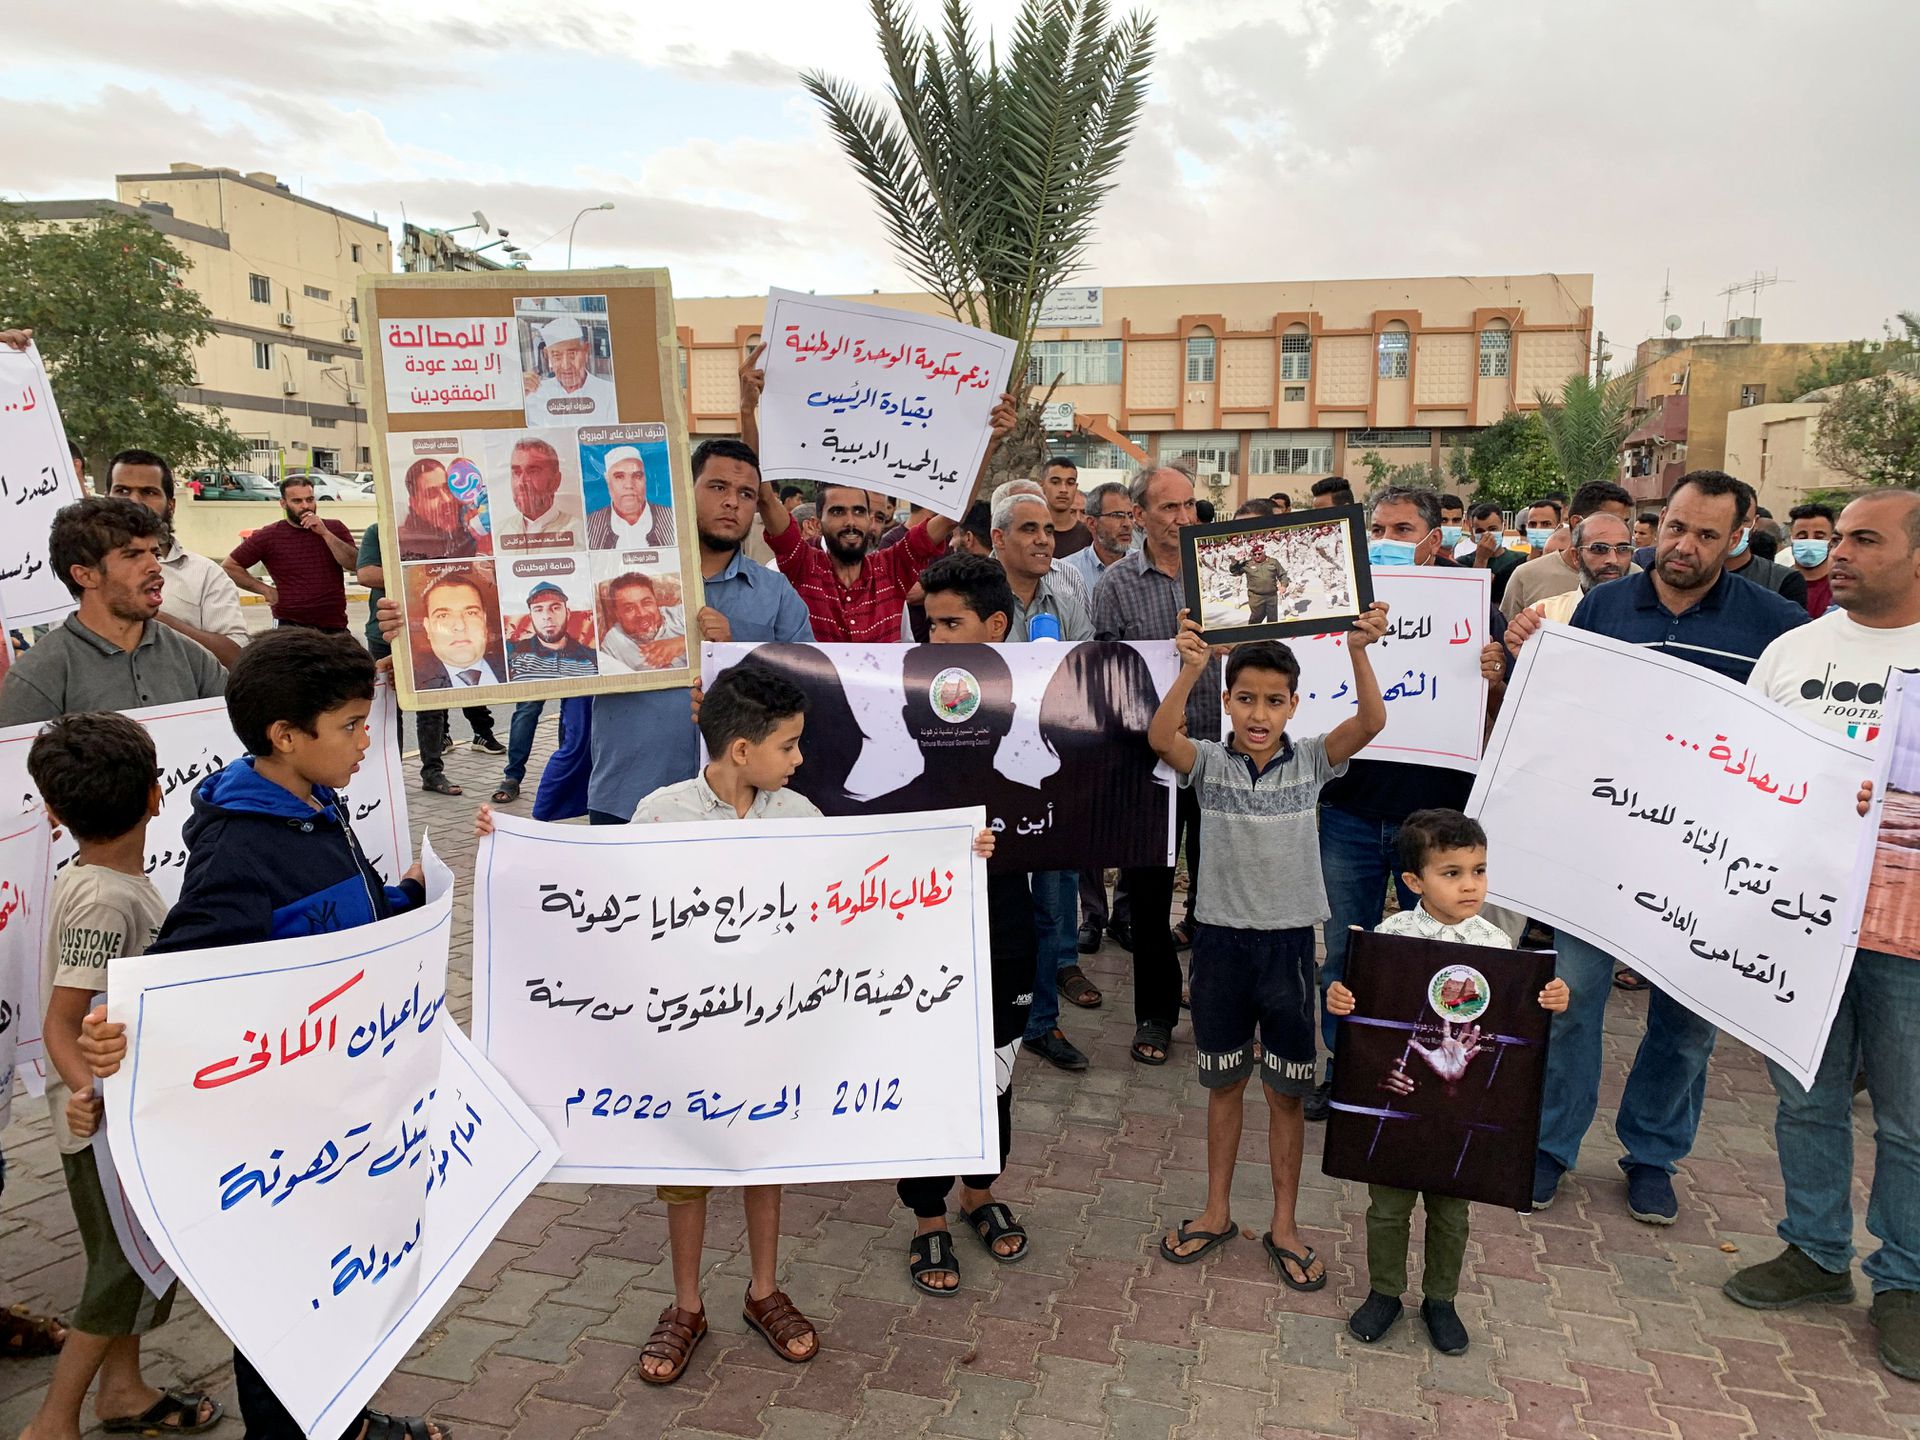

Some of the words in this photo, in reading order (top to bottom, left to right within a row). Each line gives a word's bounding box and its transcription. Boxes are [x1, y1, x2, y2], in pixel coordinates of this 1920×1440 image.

[388, 324, 485, 349] للمصالحة
[494, 322, 507, 346] لا
[785, 325, 850, 363] الوطنية
[405, 355, 446, 375] عودة
[451, 358, 479, 375] بعد
[484, 352, 501, 375] إلا
[852, 339, 912, 369] الوحدة
[915, 347, 963, 381] حكومة
[411, 383, 496, 405] المفقودين
[806, 379, 878, 414] الرئيس
[954, 364, 991, 396] ندعم
[878, 391, 934, 428] بقيادة
[579, 430, 608, 441] المبروك
[625, 427, 644, 438] الدين
[645, 426, 665, 440] شرف
[821, 428, 889, 463] الدبيبة
[1449, 617, 1472, 645] لا
[1800, 662, 1892, 705] diad
[1823, 704, 1884, 720] FOOTB
[1016, 801, 1054, 835] أين
[1591, 777, 1677, 825] للعدالة
[1682, 819, 1728, 865] الجناة
[889, 867, 954, 921] نطالب
[1724, 857, 1779, 896] تقديم
[539, 883, 642, 934] ترهونة
[650, 885, 710, 942] ضحايا
[713, 880, 798, 945] بإدراج
[1634, 891, 1698, 937] العادل
[1770, 891, 1838, 935] قبل
[917, 964, 965, 1015] ضمن
[1689, 938, 1795, 1004] والقصاص
[347, 960, 424, 1059] أعيان
[525, 976, 594, 1016] سنة
[854, 968, 914, 1016] هيئة
[592, 1001, 634, 1024] من
[1218, 1049, 1243, 1071] NYC
[1285, 1062, 1313, 1080] NYC
[686, 1089, 746, 1129] سنة
[747, 1083, 802, 1123] إلى
[832, 1077, 903, 1118] 2012
[219, 1121, 373, 1212] ترهونة
